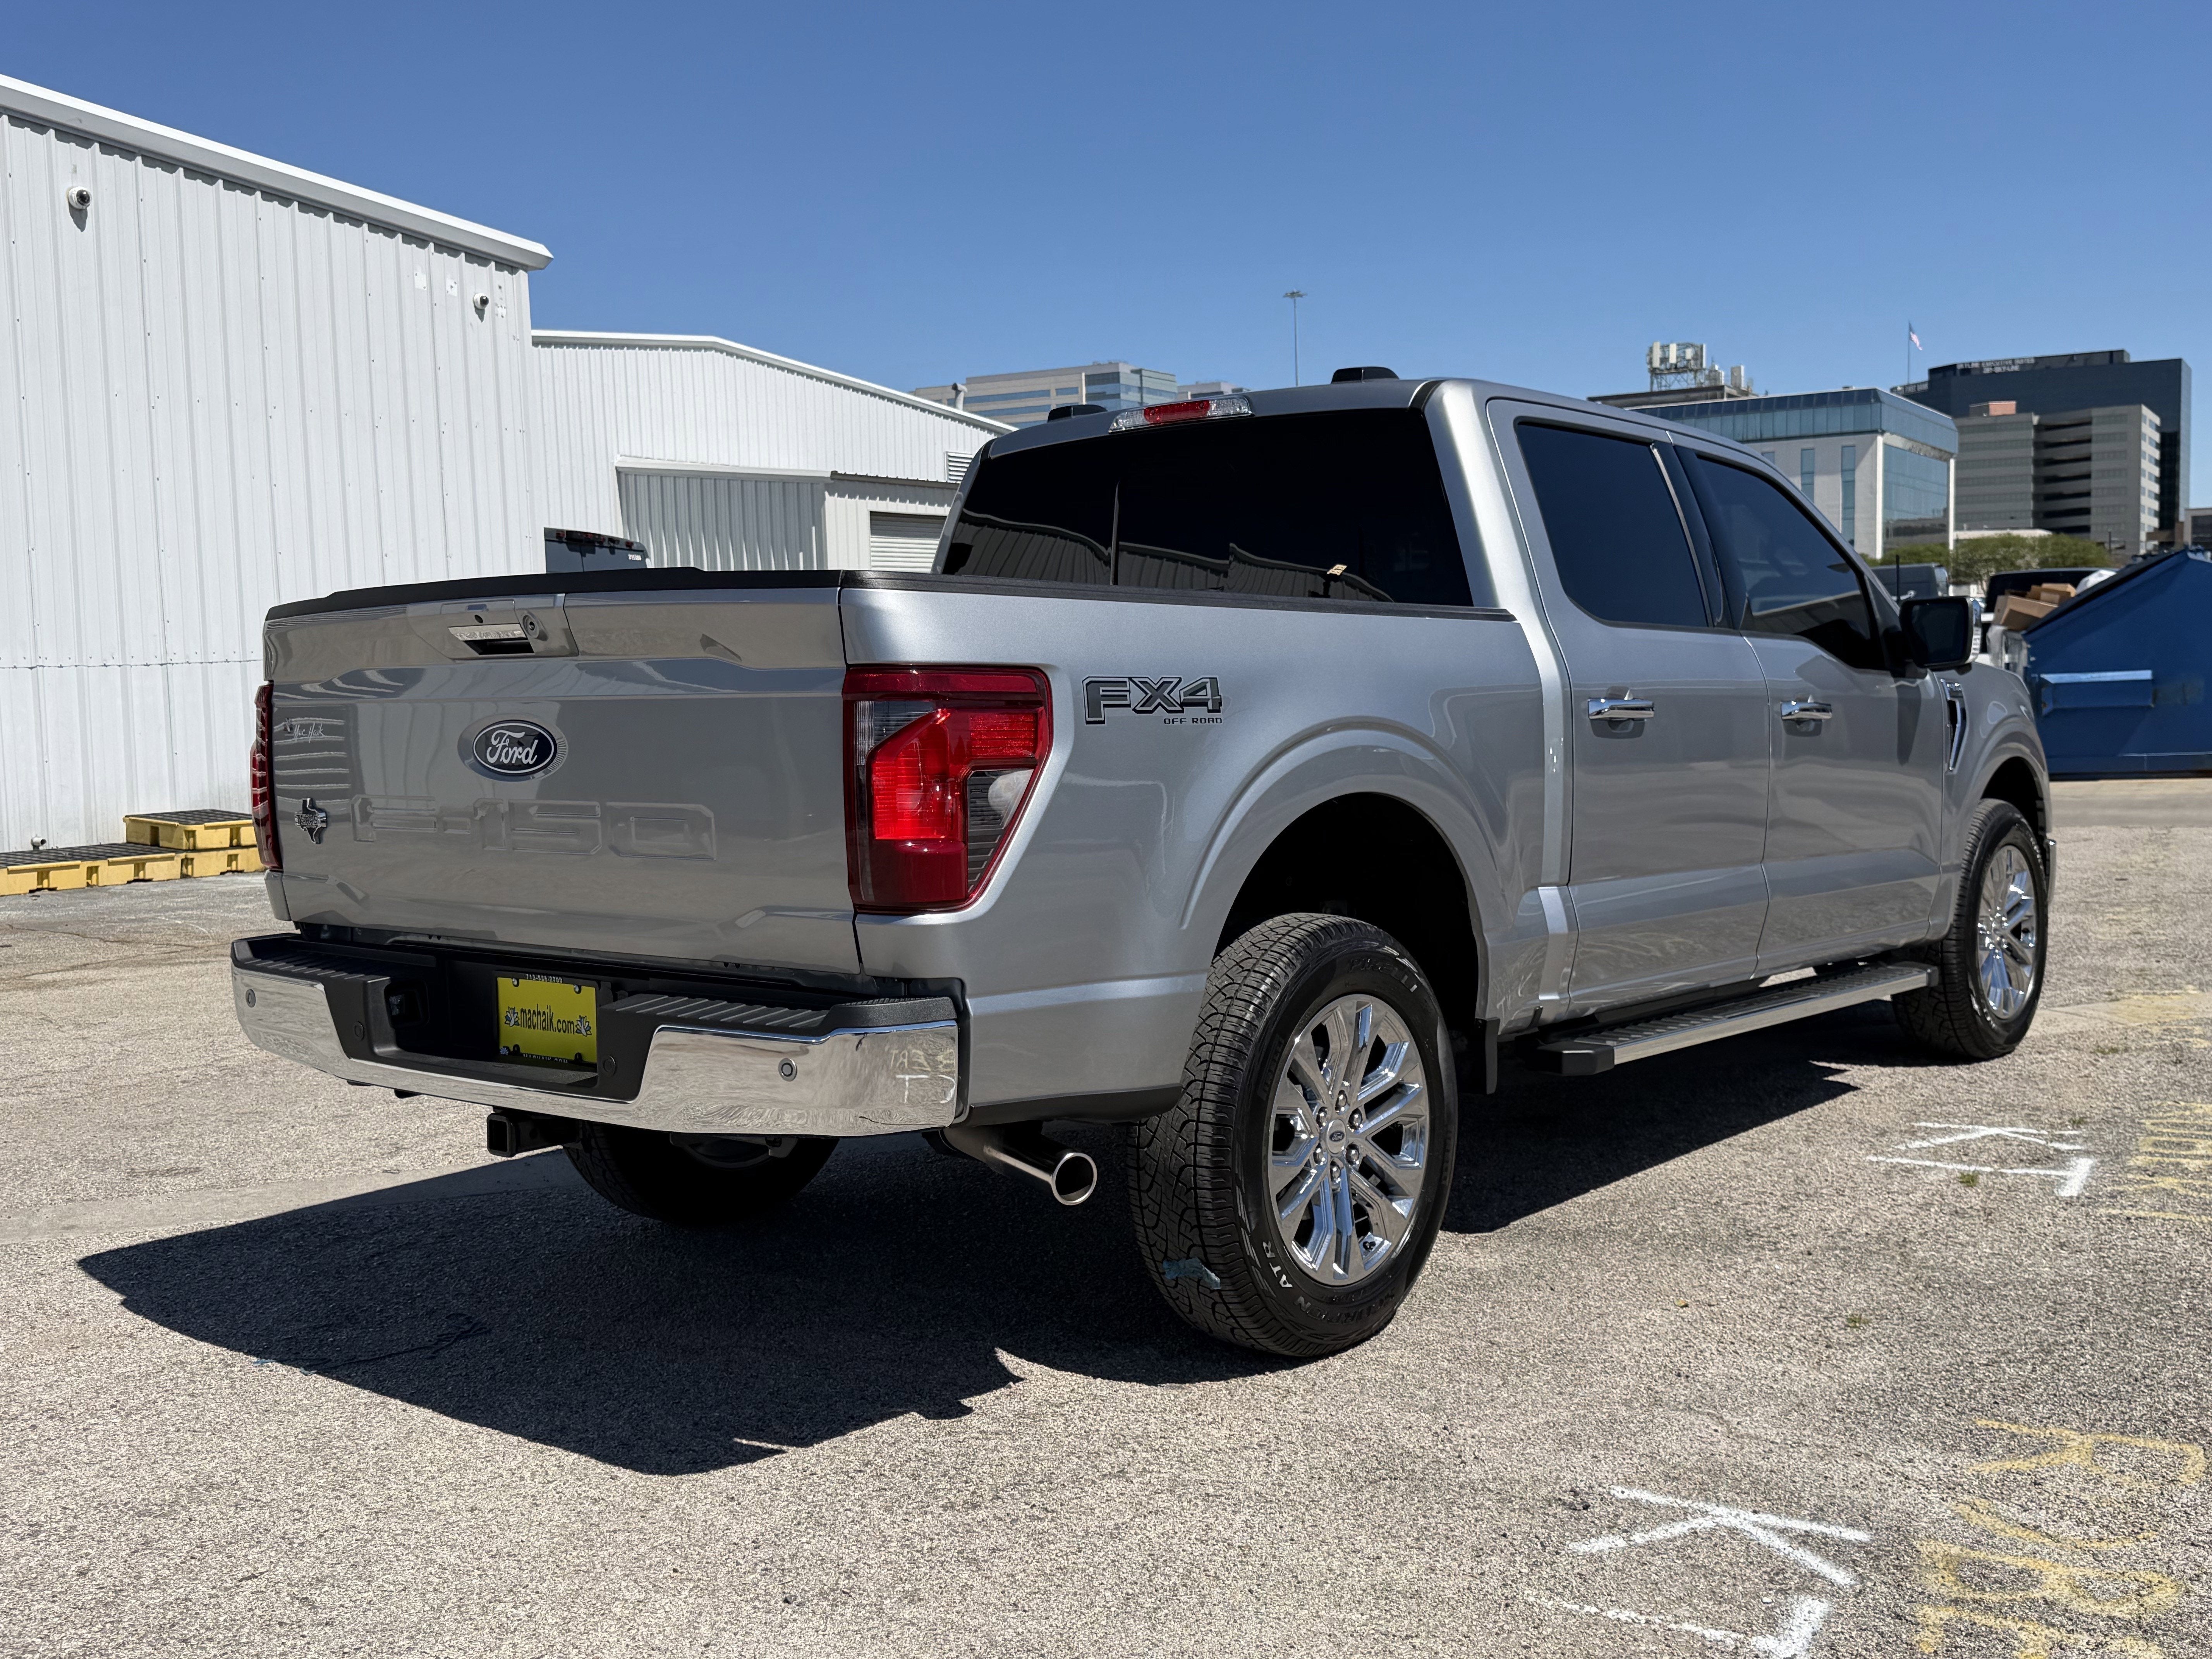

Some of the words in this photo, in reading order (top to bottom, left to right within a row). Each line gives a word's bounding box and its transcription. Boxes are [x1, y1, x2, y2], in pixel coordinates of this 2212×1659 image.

[1082, 676, 1222, 725] FX4
[486, 730, 539, 764] Ford
[297, 814, 319, 825] TEXAS
[351, 795, 716, 861] F-150
[520, 1003, 575, 1035] machaik.com
[1262, 1240, 1293, 1288] ATR
